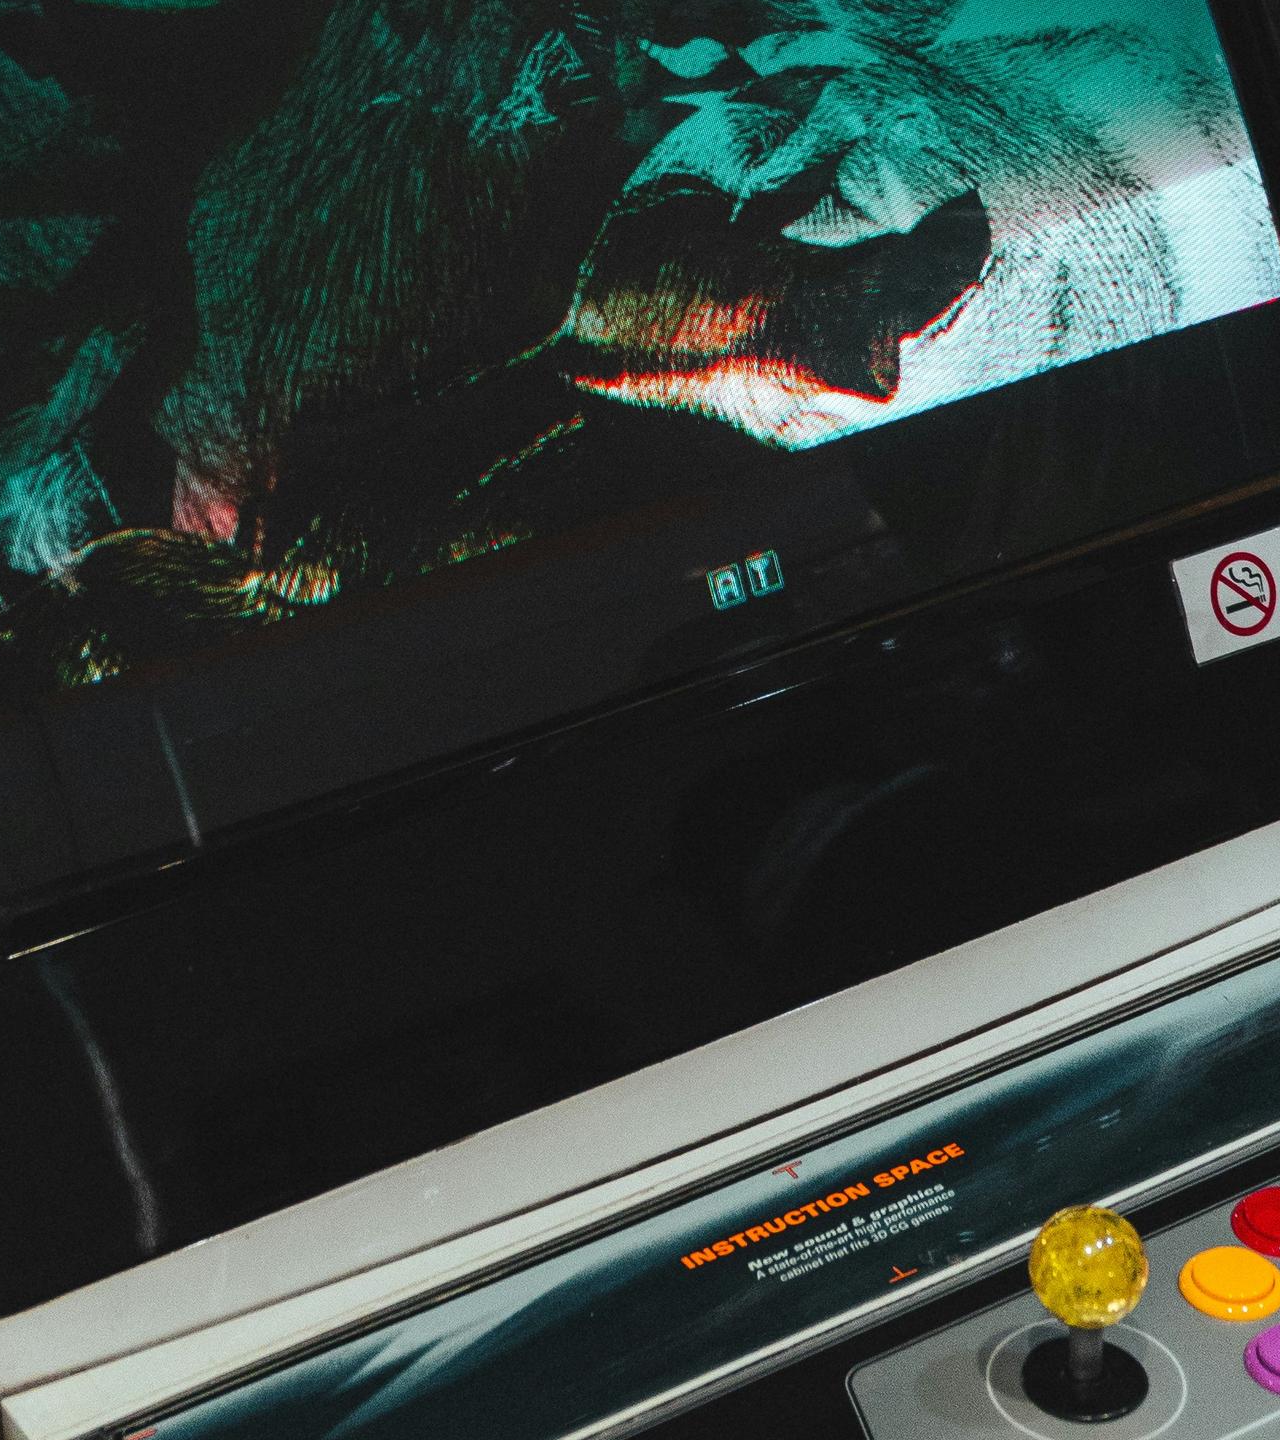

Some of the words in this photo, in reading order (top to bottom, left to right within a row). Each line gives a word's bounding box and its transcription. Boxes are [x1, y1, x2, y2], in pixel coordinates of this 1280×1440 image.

[681, 1182, 872, 1270] INSTRUCTION
[873, 1142, 965, 1189] SPACE
[748, 1245, 790, 1271] New
[793, 1222, 848, 1252] sound
[869, 1183, 945, 1222] graphics
[855, 1219, 882, 1242] high
[882, 1189, 956, 1232] performance
[780, 1261, 824, 1283] cabinet
[825, 1248, 850, 1267] that
[851, 1240, 872, 1257] fits
[872, 1229, 889, 1245] 3D
[889, 1219, 910, 1237] CG
